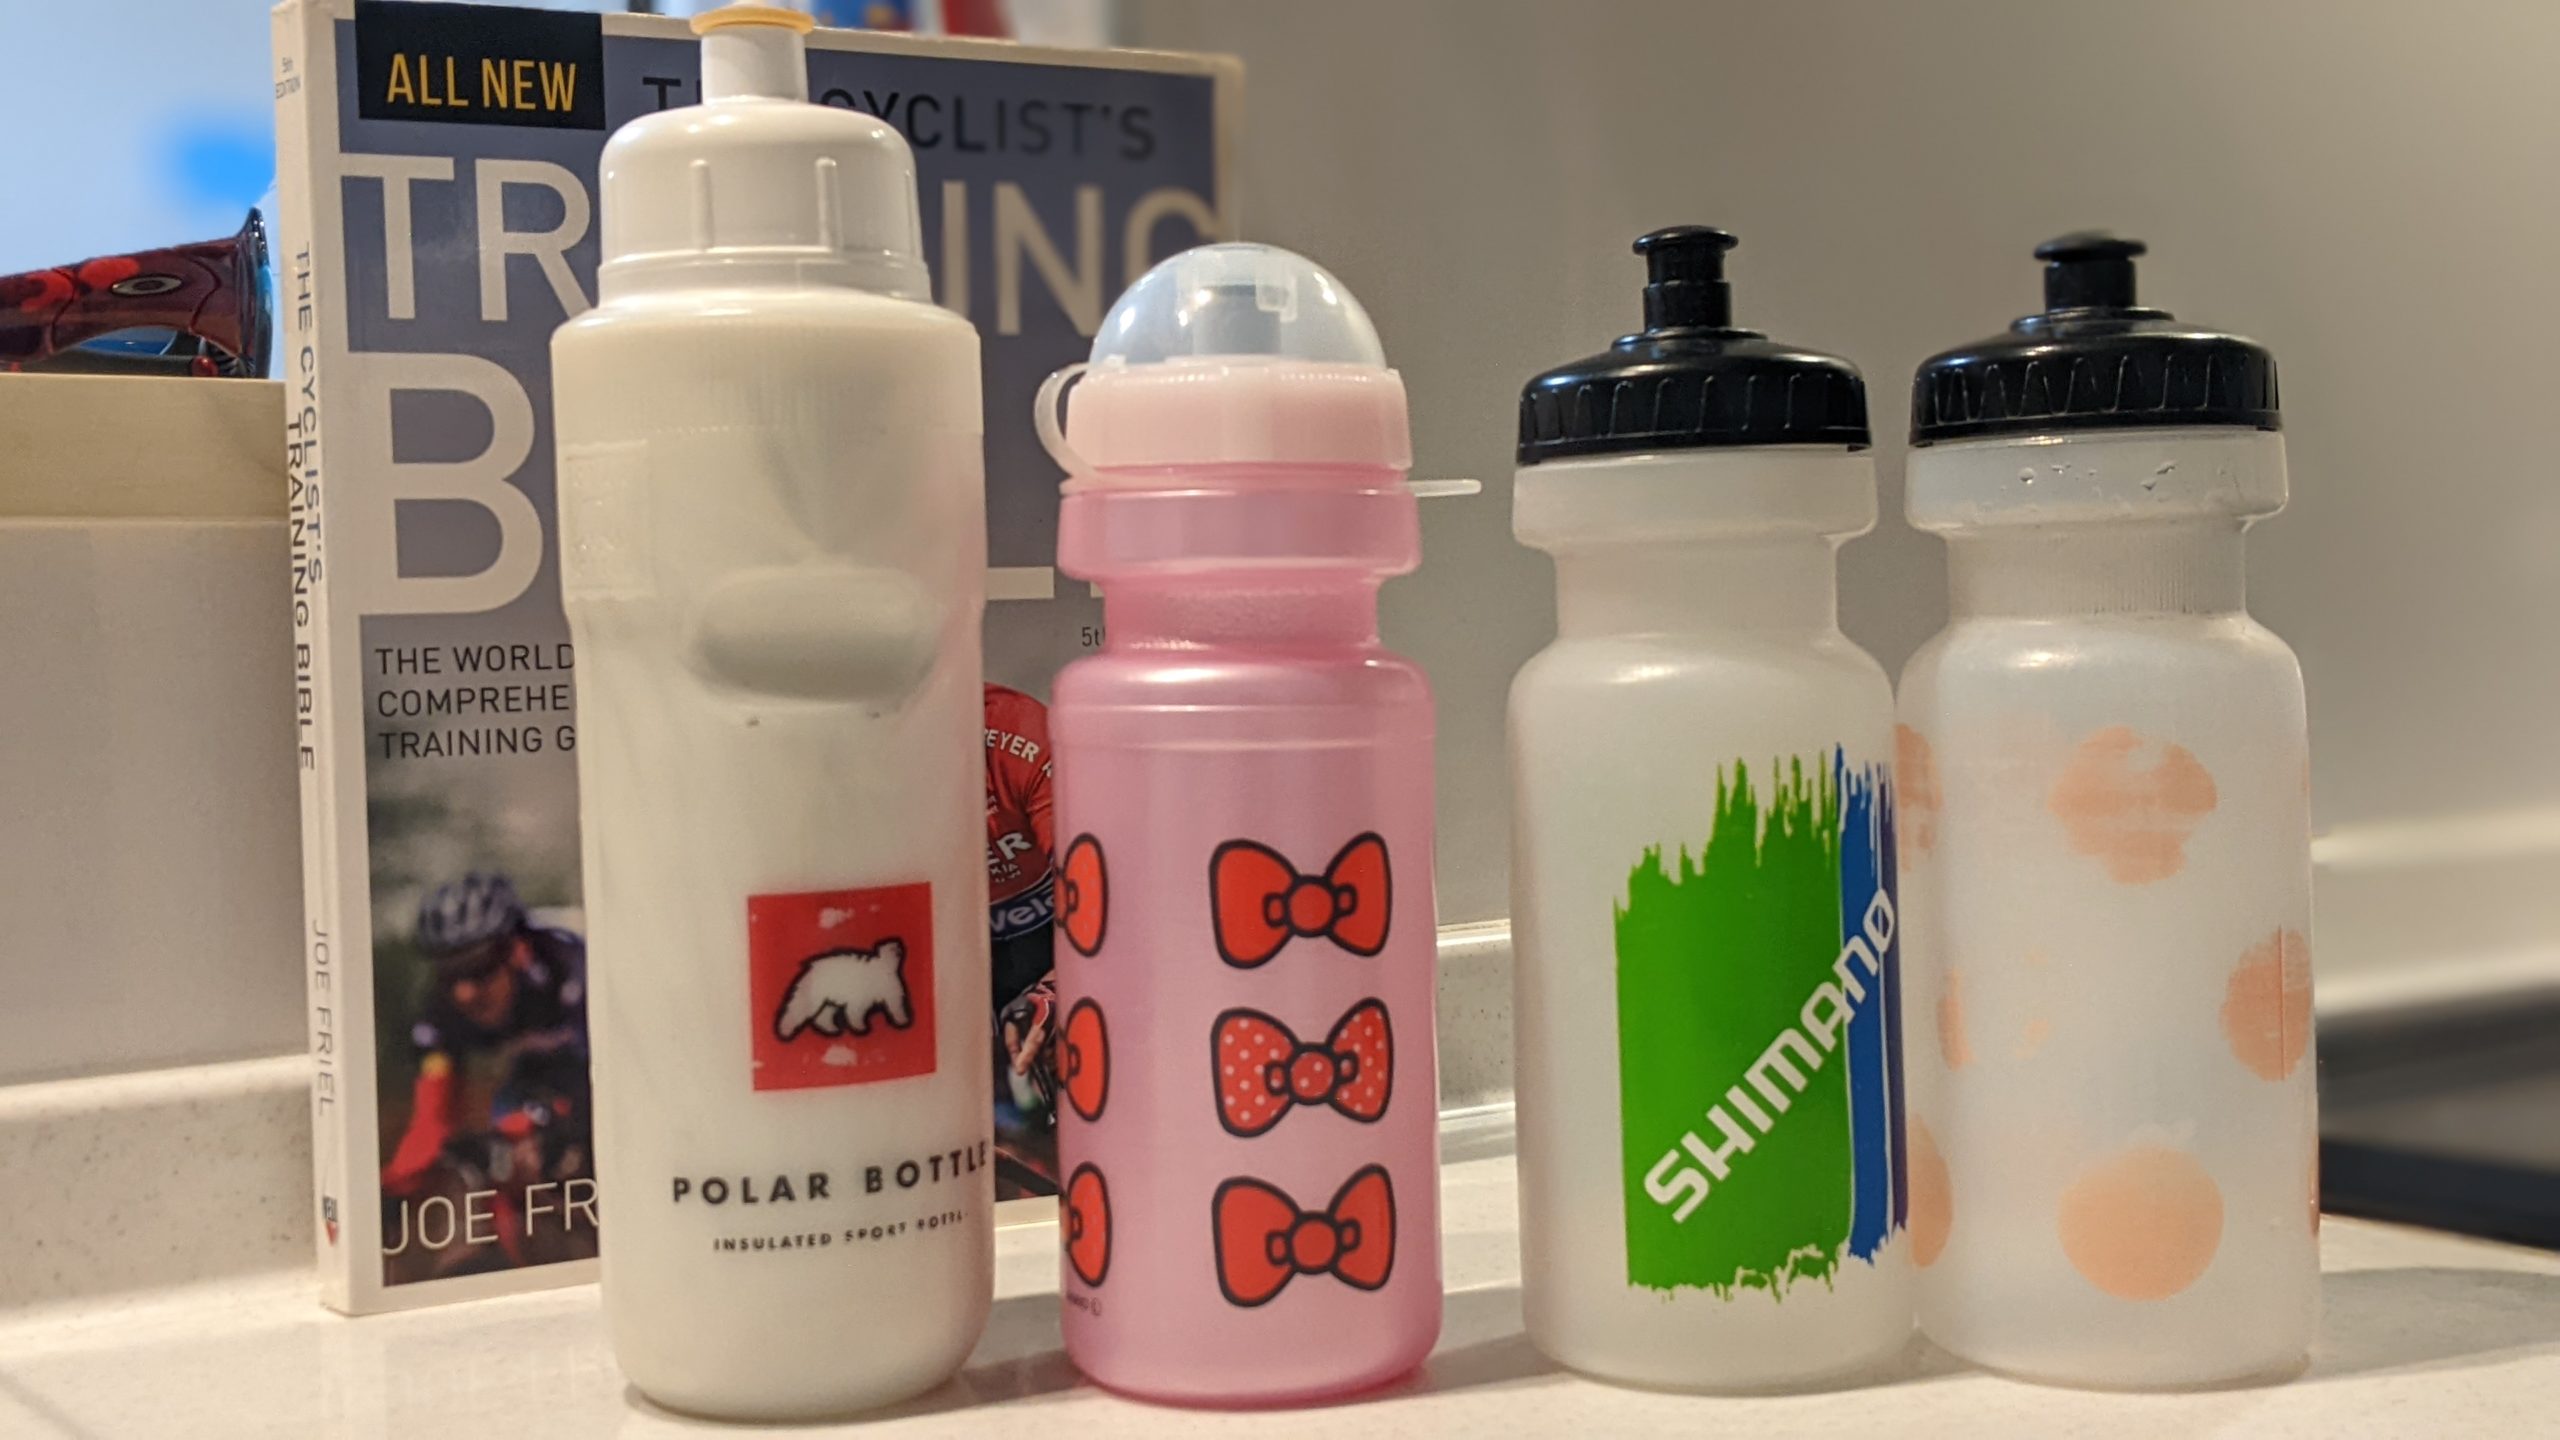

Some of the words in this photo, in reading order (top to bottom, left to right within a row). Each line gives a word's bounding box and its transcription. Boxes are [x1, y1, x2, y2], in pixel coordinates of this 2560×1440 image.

[386, 53, 468, 107] ALL
[482, 59, 576, 112] NEW
[296, 242, 313, 332] THE
[300, 346, 323, 584] CYCLIST'S
[288, 414, 310, 628] TRAINING
[375, 647, 442, 675] THE
[1081, 626, 1104, 647] 5t
[296, 643, 315, 771] BIBLE
[378, 685, 570, 718] COMPREHE
[379, 727, 543, 758] TRAINING
[314, 919, 330, 991] JOE
[317, 1006, 335, 1117] FRIEL
[1644, 889, 1895, 1224] SHIMANO
[672, 1172, 830, 1205] POLAR
[864, 1141, 986, 1194] BOTTLE
[383, 1190, 500, 1256] JOE
[714, 1232, 832, 1252] INSULATED
[844, 1222, 907, 1243] SPORT
